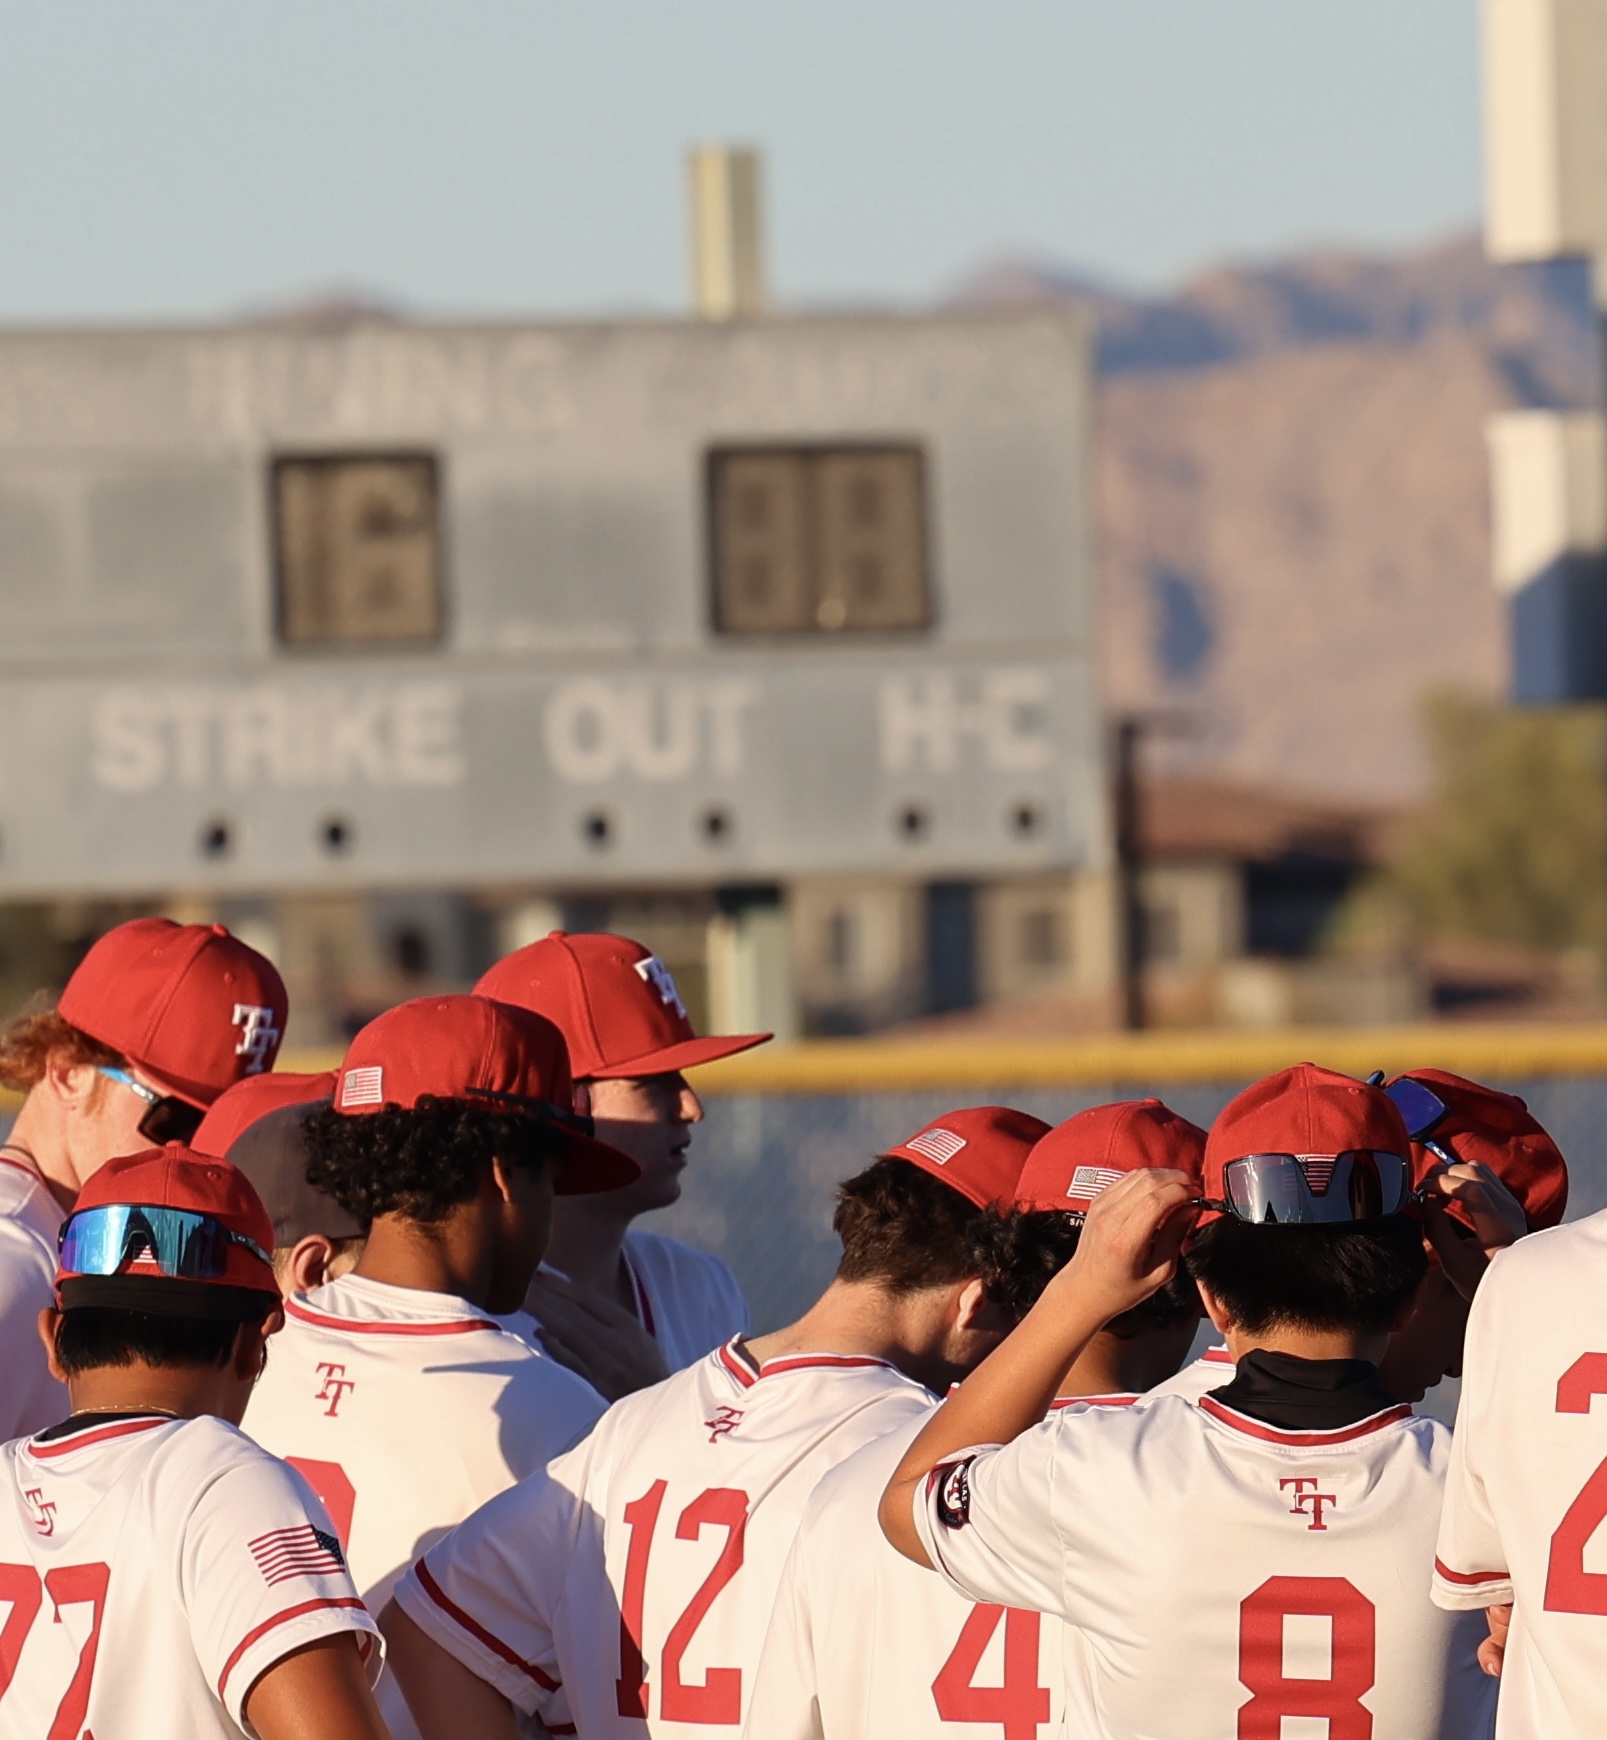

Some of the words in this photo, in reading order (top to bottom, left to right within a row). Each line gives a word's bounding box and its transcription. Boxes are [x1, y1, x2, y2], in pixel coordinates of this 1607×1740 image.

[91, 682, 466, 791] STRIKE
[543, 674, 756, 782] OUT
[314, 1361, 356, 1418] TT
[1278, 1477, 1337, 1531] TT
[615, 1478, 750, 1726] 12
